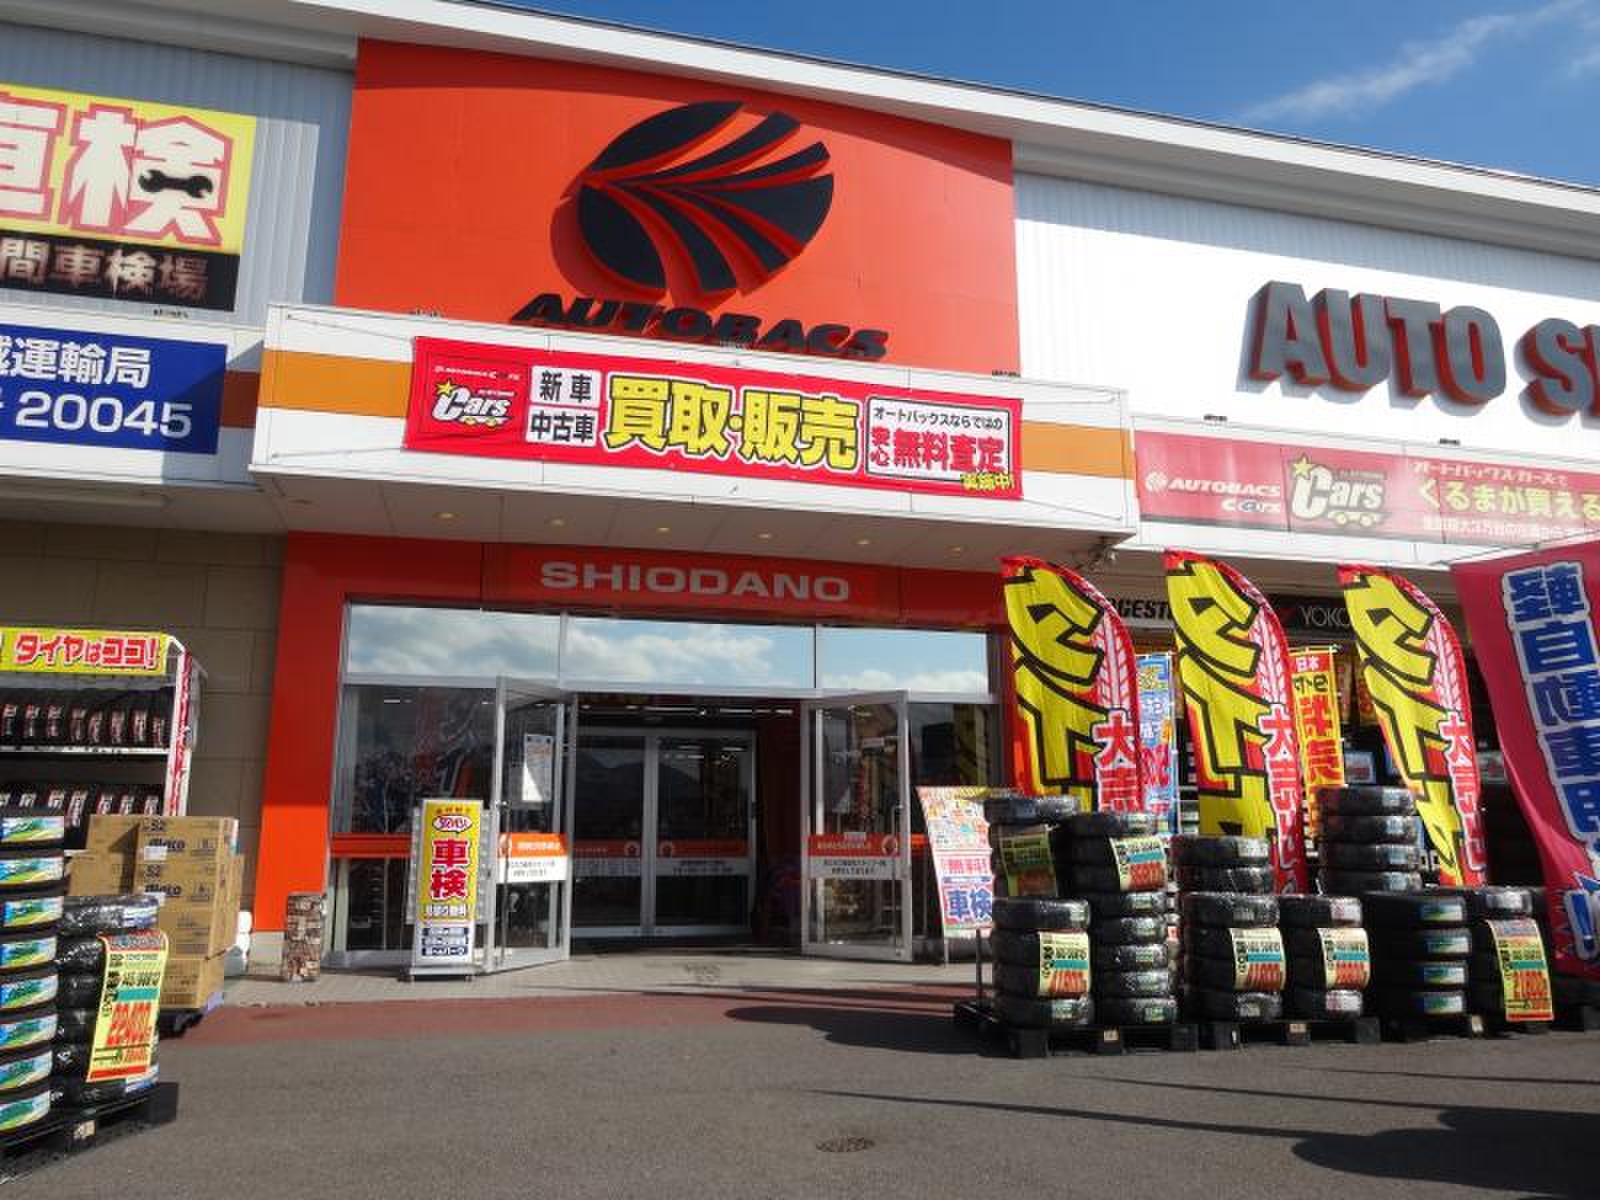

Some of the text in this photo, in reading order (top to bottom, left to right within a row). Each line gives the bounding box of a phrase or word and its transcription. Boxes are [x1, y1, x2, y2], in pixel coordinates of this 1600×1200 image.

[509, 293, 889, 361] AUTOBACS
[1248, 280, 1600, 417] AUTO S
[431, 386, 512, 420] Cars
[539, 369, 593, 403] 新車
[15, 391, 193, 439] 20045
[530, 409, 596, 443] 中古車
[873, 406, 1004, 431] オートバックスならではの
[1169, 479, 1281, 497] AUTOBACS
[1291, 464, 1385, 519] Cars
[540, 561, 849, 601] SHIODANO
[15, 631, 160, 669] タイヤはココ!
[430, 837, 471, 900] 車検
[946, 886, 993, 922] 車検
